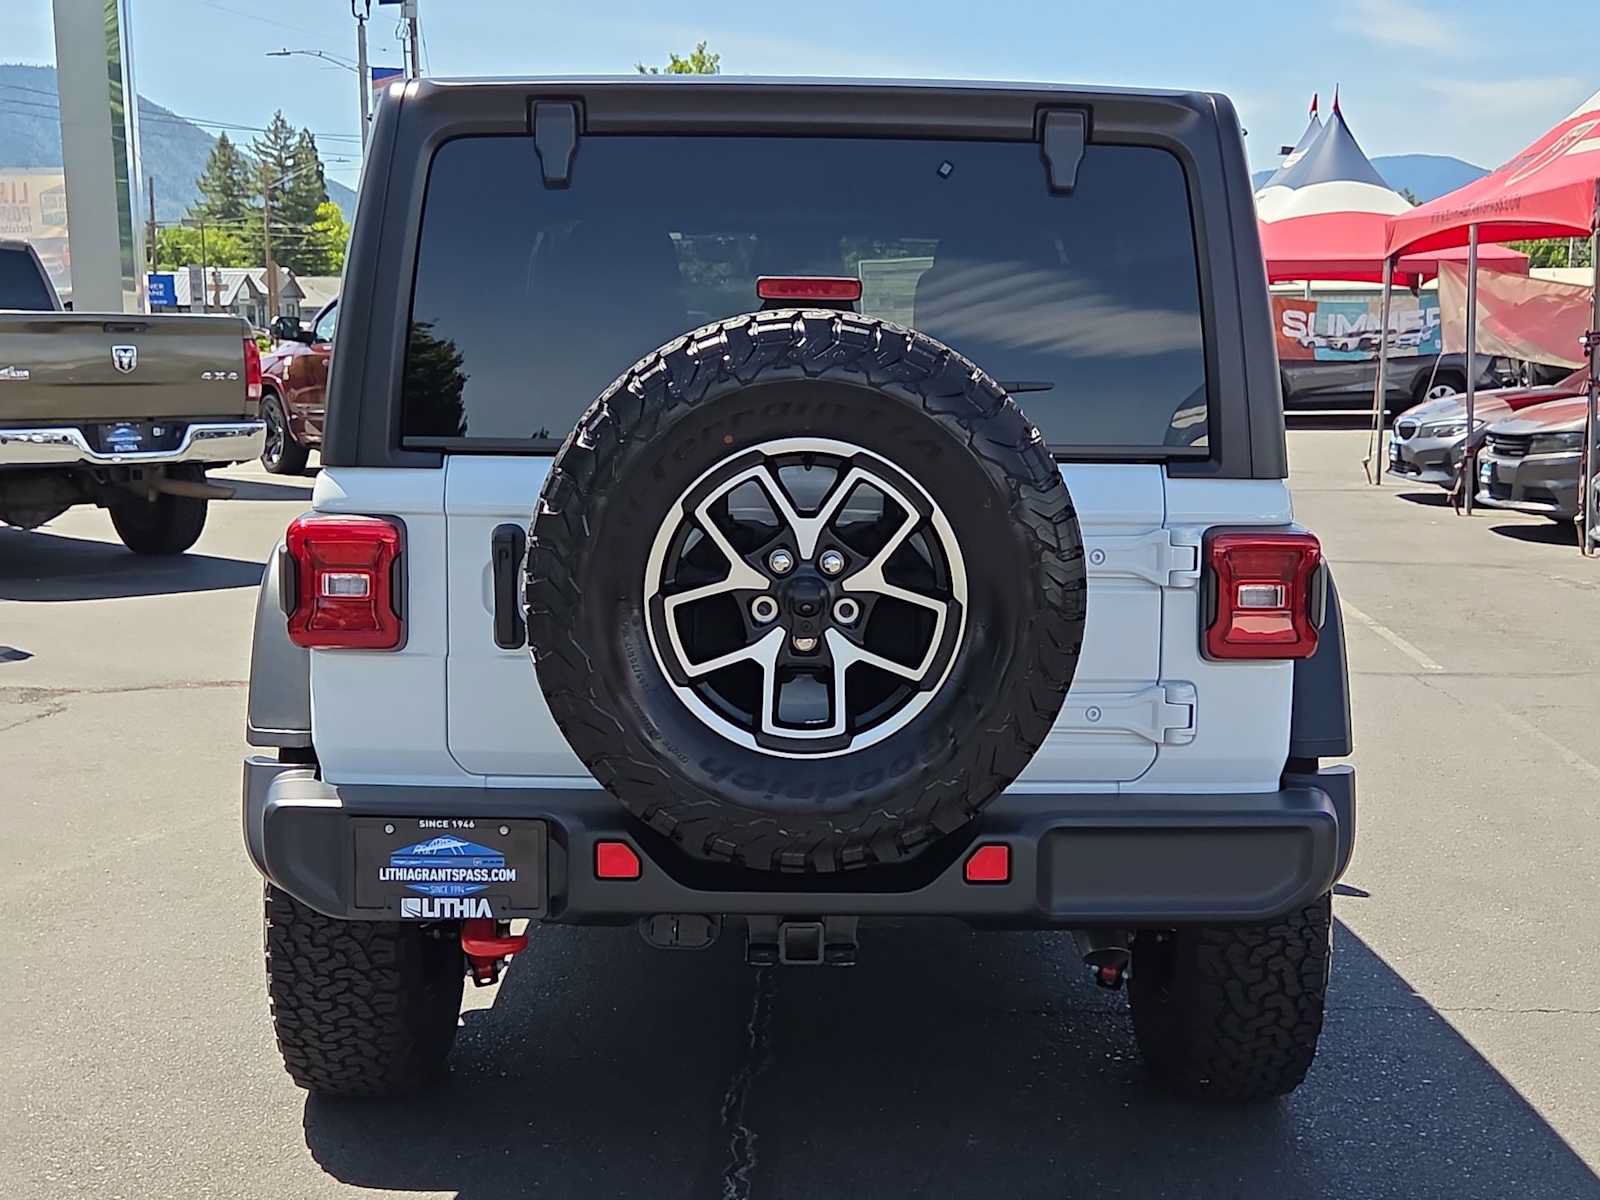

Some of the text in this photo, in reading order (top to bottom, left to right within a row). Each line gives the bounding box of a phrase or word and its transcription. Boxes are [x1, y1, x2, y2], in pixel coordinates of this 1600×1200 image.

[419, 819, 475, 828] SINCE 1946
[379, 867, 516, 882] LITHIAGRANTSPASS.COM
[422, 897, 493, 918] LITHIA
